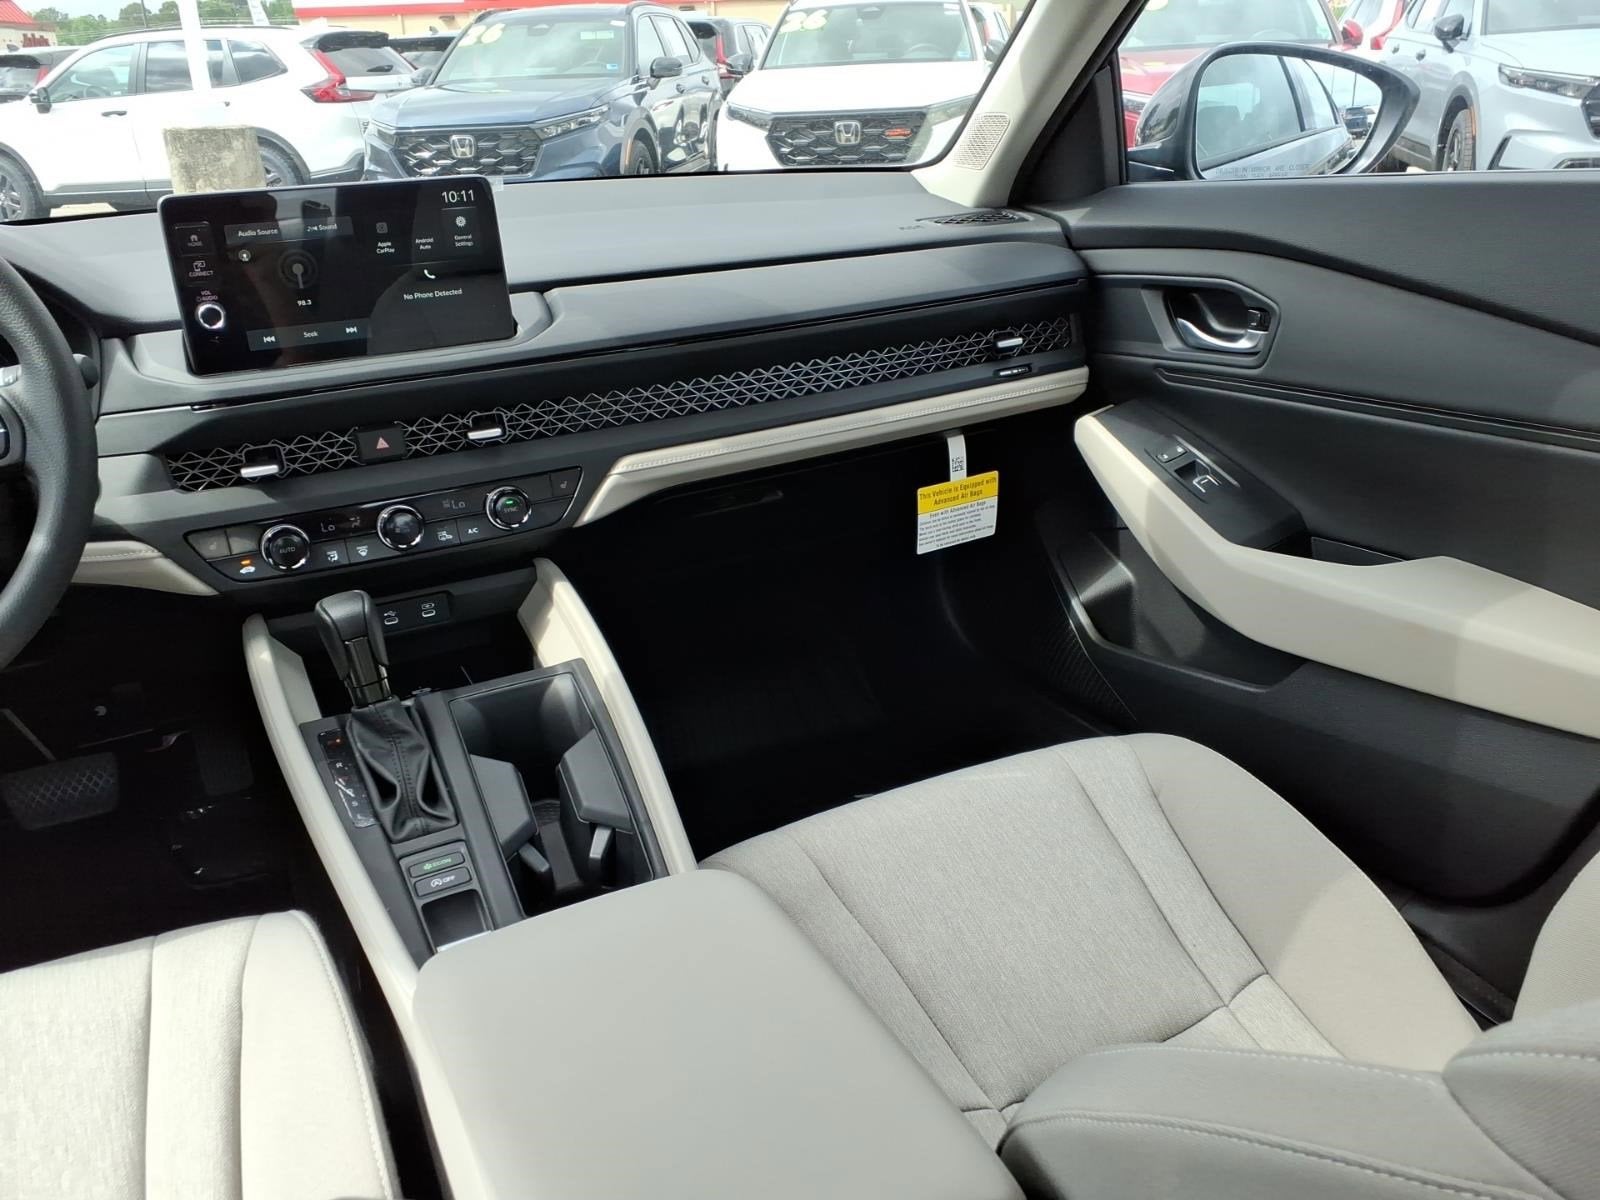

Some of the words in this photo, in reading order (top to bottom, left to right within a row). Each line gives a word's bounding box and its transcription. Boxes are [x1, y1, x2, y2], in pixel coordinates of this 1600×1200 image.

[442, 190, 475, 203] 10:11
[319, 223, 338, 231] Sound
[238, 230, 257, 238] Audio
[257, 228, 279, 236] Source
[414, 291, 434, 299] Phone
[435, 288, 463, 297] Detected
[303, 330, 319, 338] Seek
[932, 487, 953, 497] Vehicle
[960, 480, 985, 492] Equipped
[933, 495, 960, 506] Advanced
[970, 489, 983, 498] Bags
[467, 527, 480, 535] A/C
[279, 546, 296, 554] AUTO
